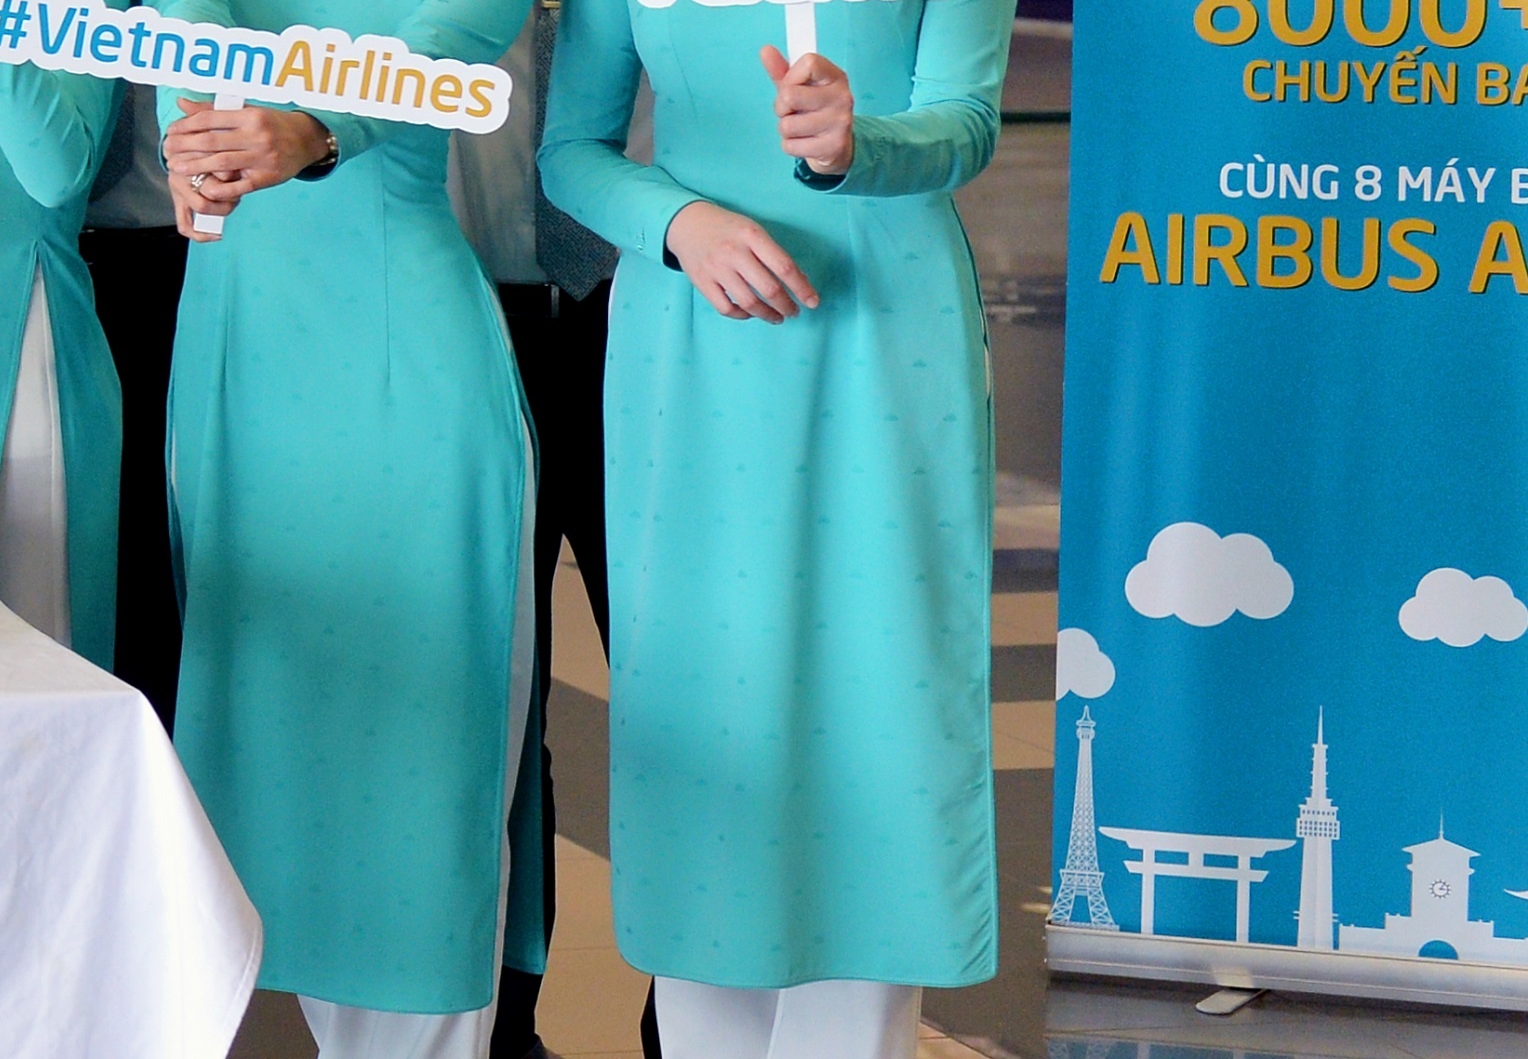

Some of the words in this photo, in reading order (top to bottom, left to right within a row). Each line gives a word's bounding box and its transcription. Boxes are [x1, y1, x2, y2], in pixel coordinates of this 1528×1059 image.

[1243, 45, 1458, 105] CHUYẾN
[1219, 153, 1340, 201] CÙNG
[1354, 164, 1382, 201] 8
[1397, 157, 1497, 204] MÁY
[1099, 211, 1441, 293] AIRBUS
